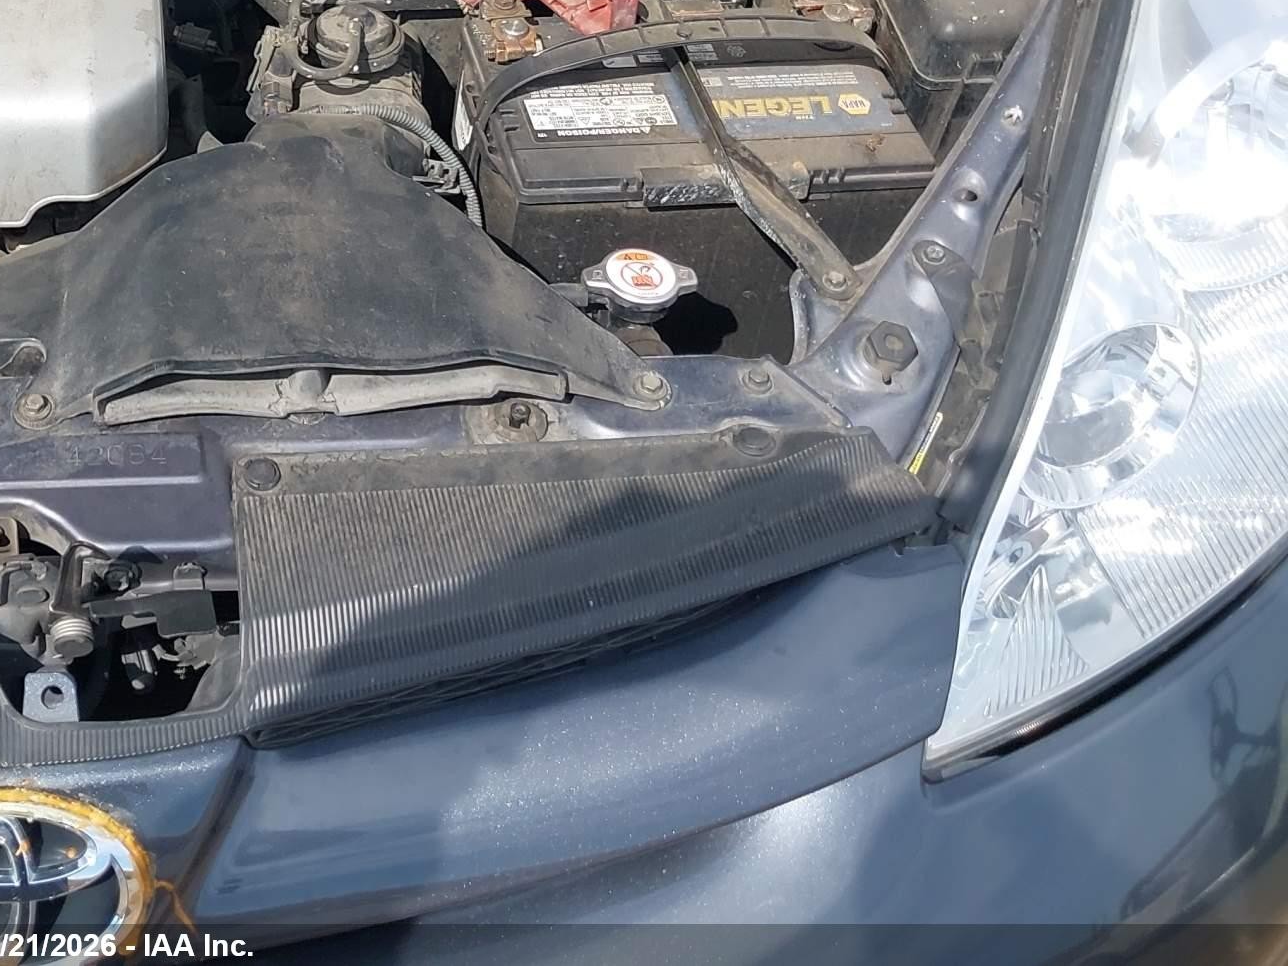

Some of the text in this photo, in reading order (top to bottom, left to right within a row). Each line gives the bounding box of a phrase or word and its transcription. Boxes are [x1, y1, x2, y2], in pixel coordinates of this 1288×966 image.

[712, 95, 833, 120] LEGEN
[842, 99, 866, 109] NAPA
[557, 126, 641, 137] DANGER/POISON
